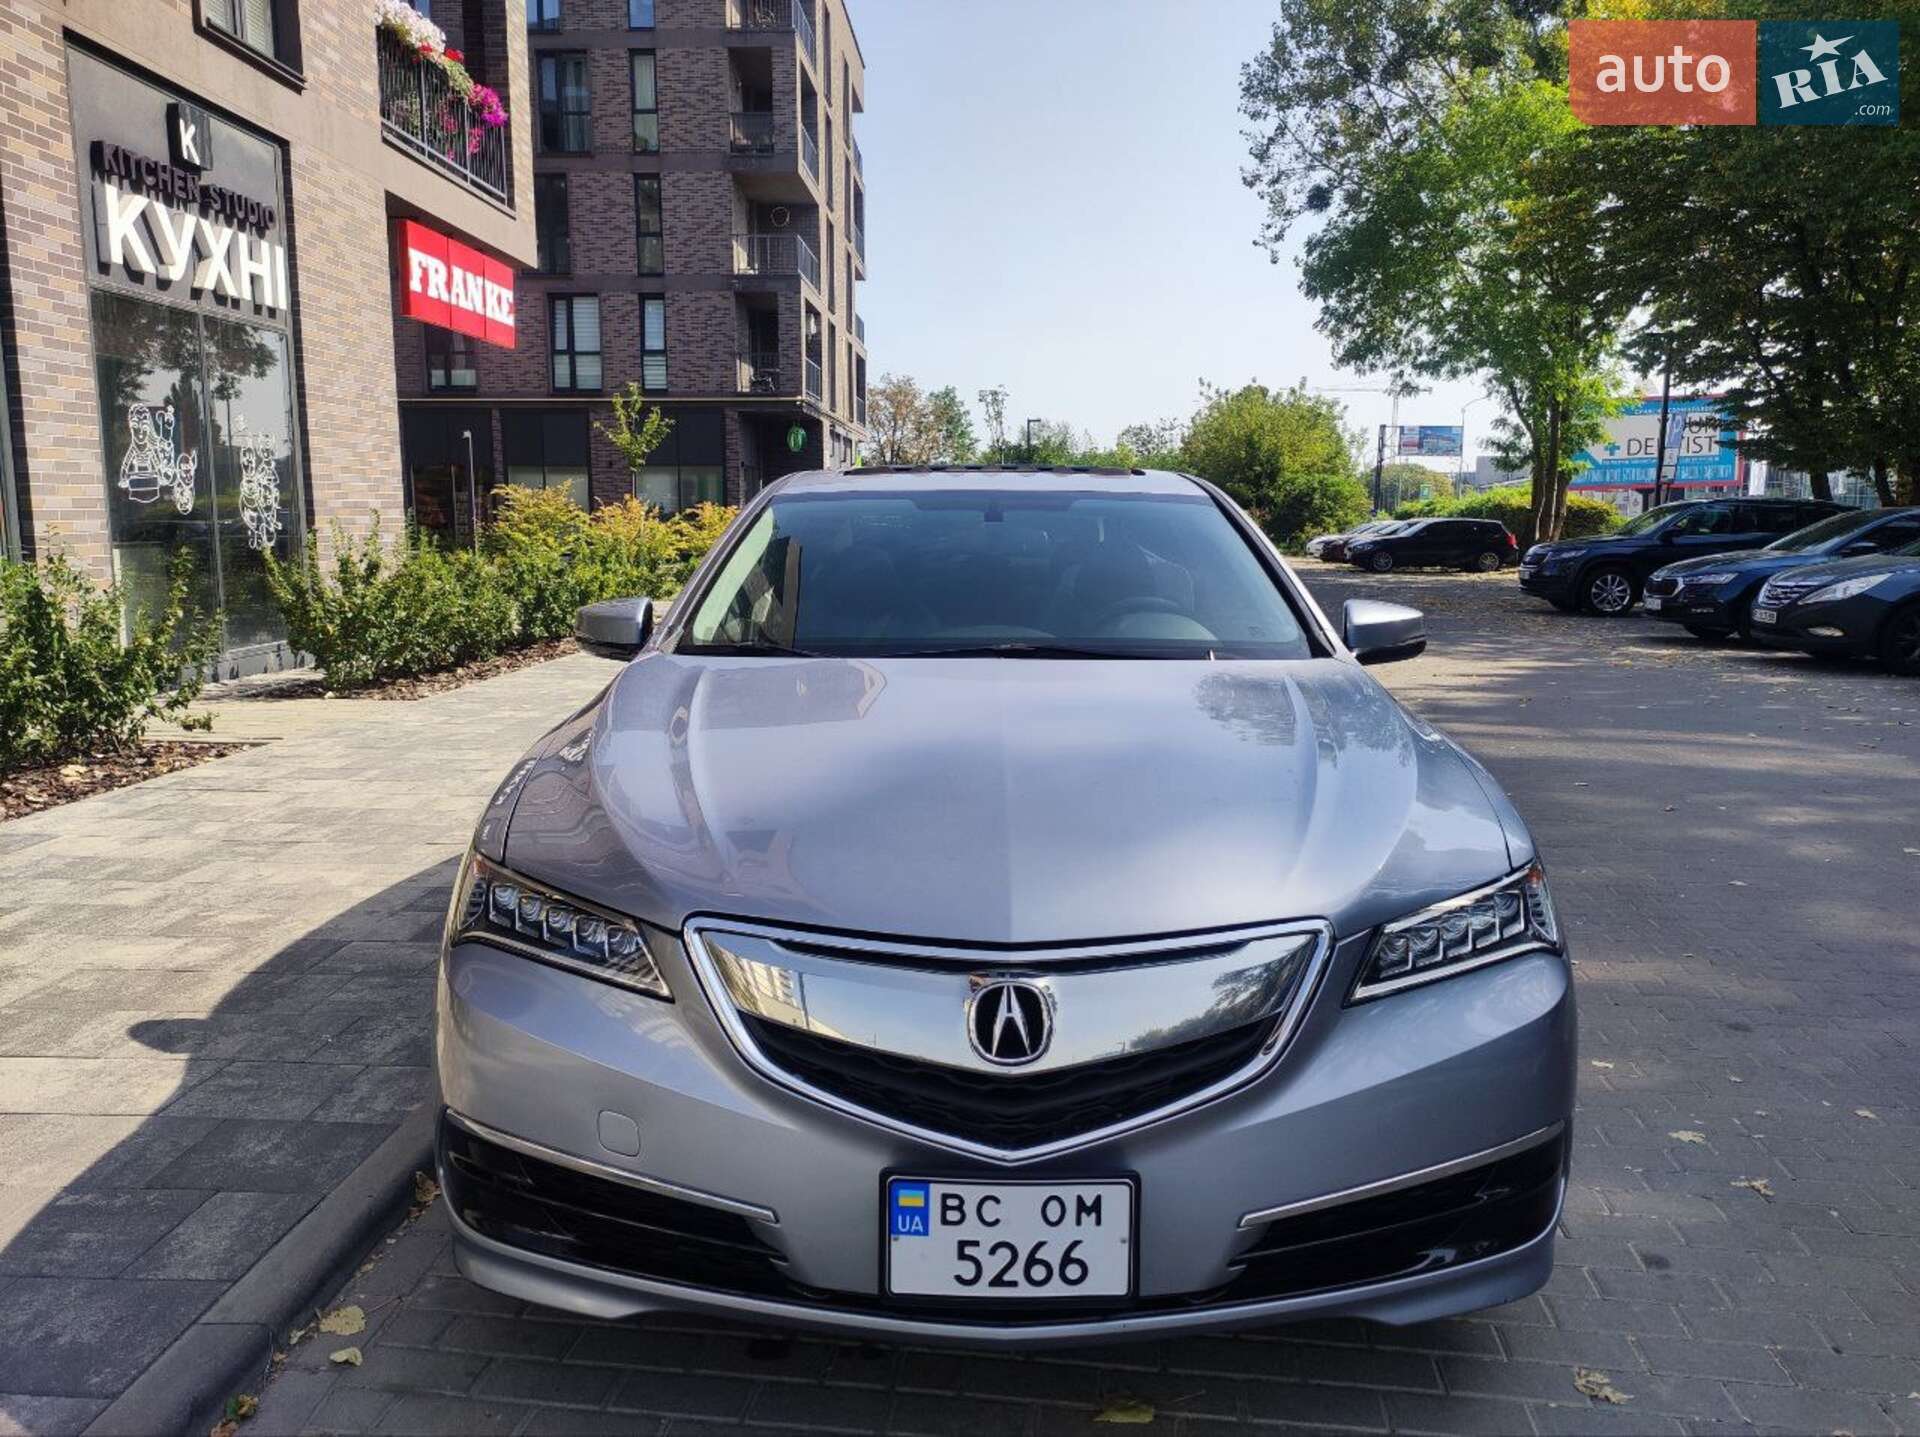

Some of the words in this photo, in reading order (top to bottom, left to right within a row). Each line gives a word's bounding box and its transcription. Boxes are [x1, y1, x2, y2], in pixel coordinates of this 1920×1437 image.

[101, 142, 201, 201] KITCHEN
[209, 184, 276, 230] STUDIO
[104, 183, 288, 310] КУХНІ
[408, 247, 515, 327] FRANKE
[1626, 435, 1717, 457] DEIST
[898, 1215, 924, 1233] UA
[940, 1193, 1002, 1227] BC
[953, 1239, 1089, 1288] 5266
